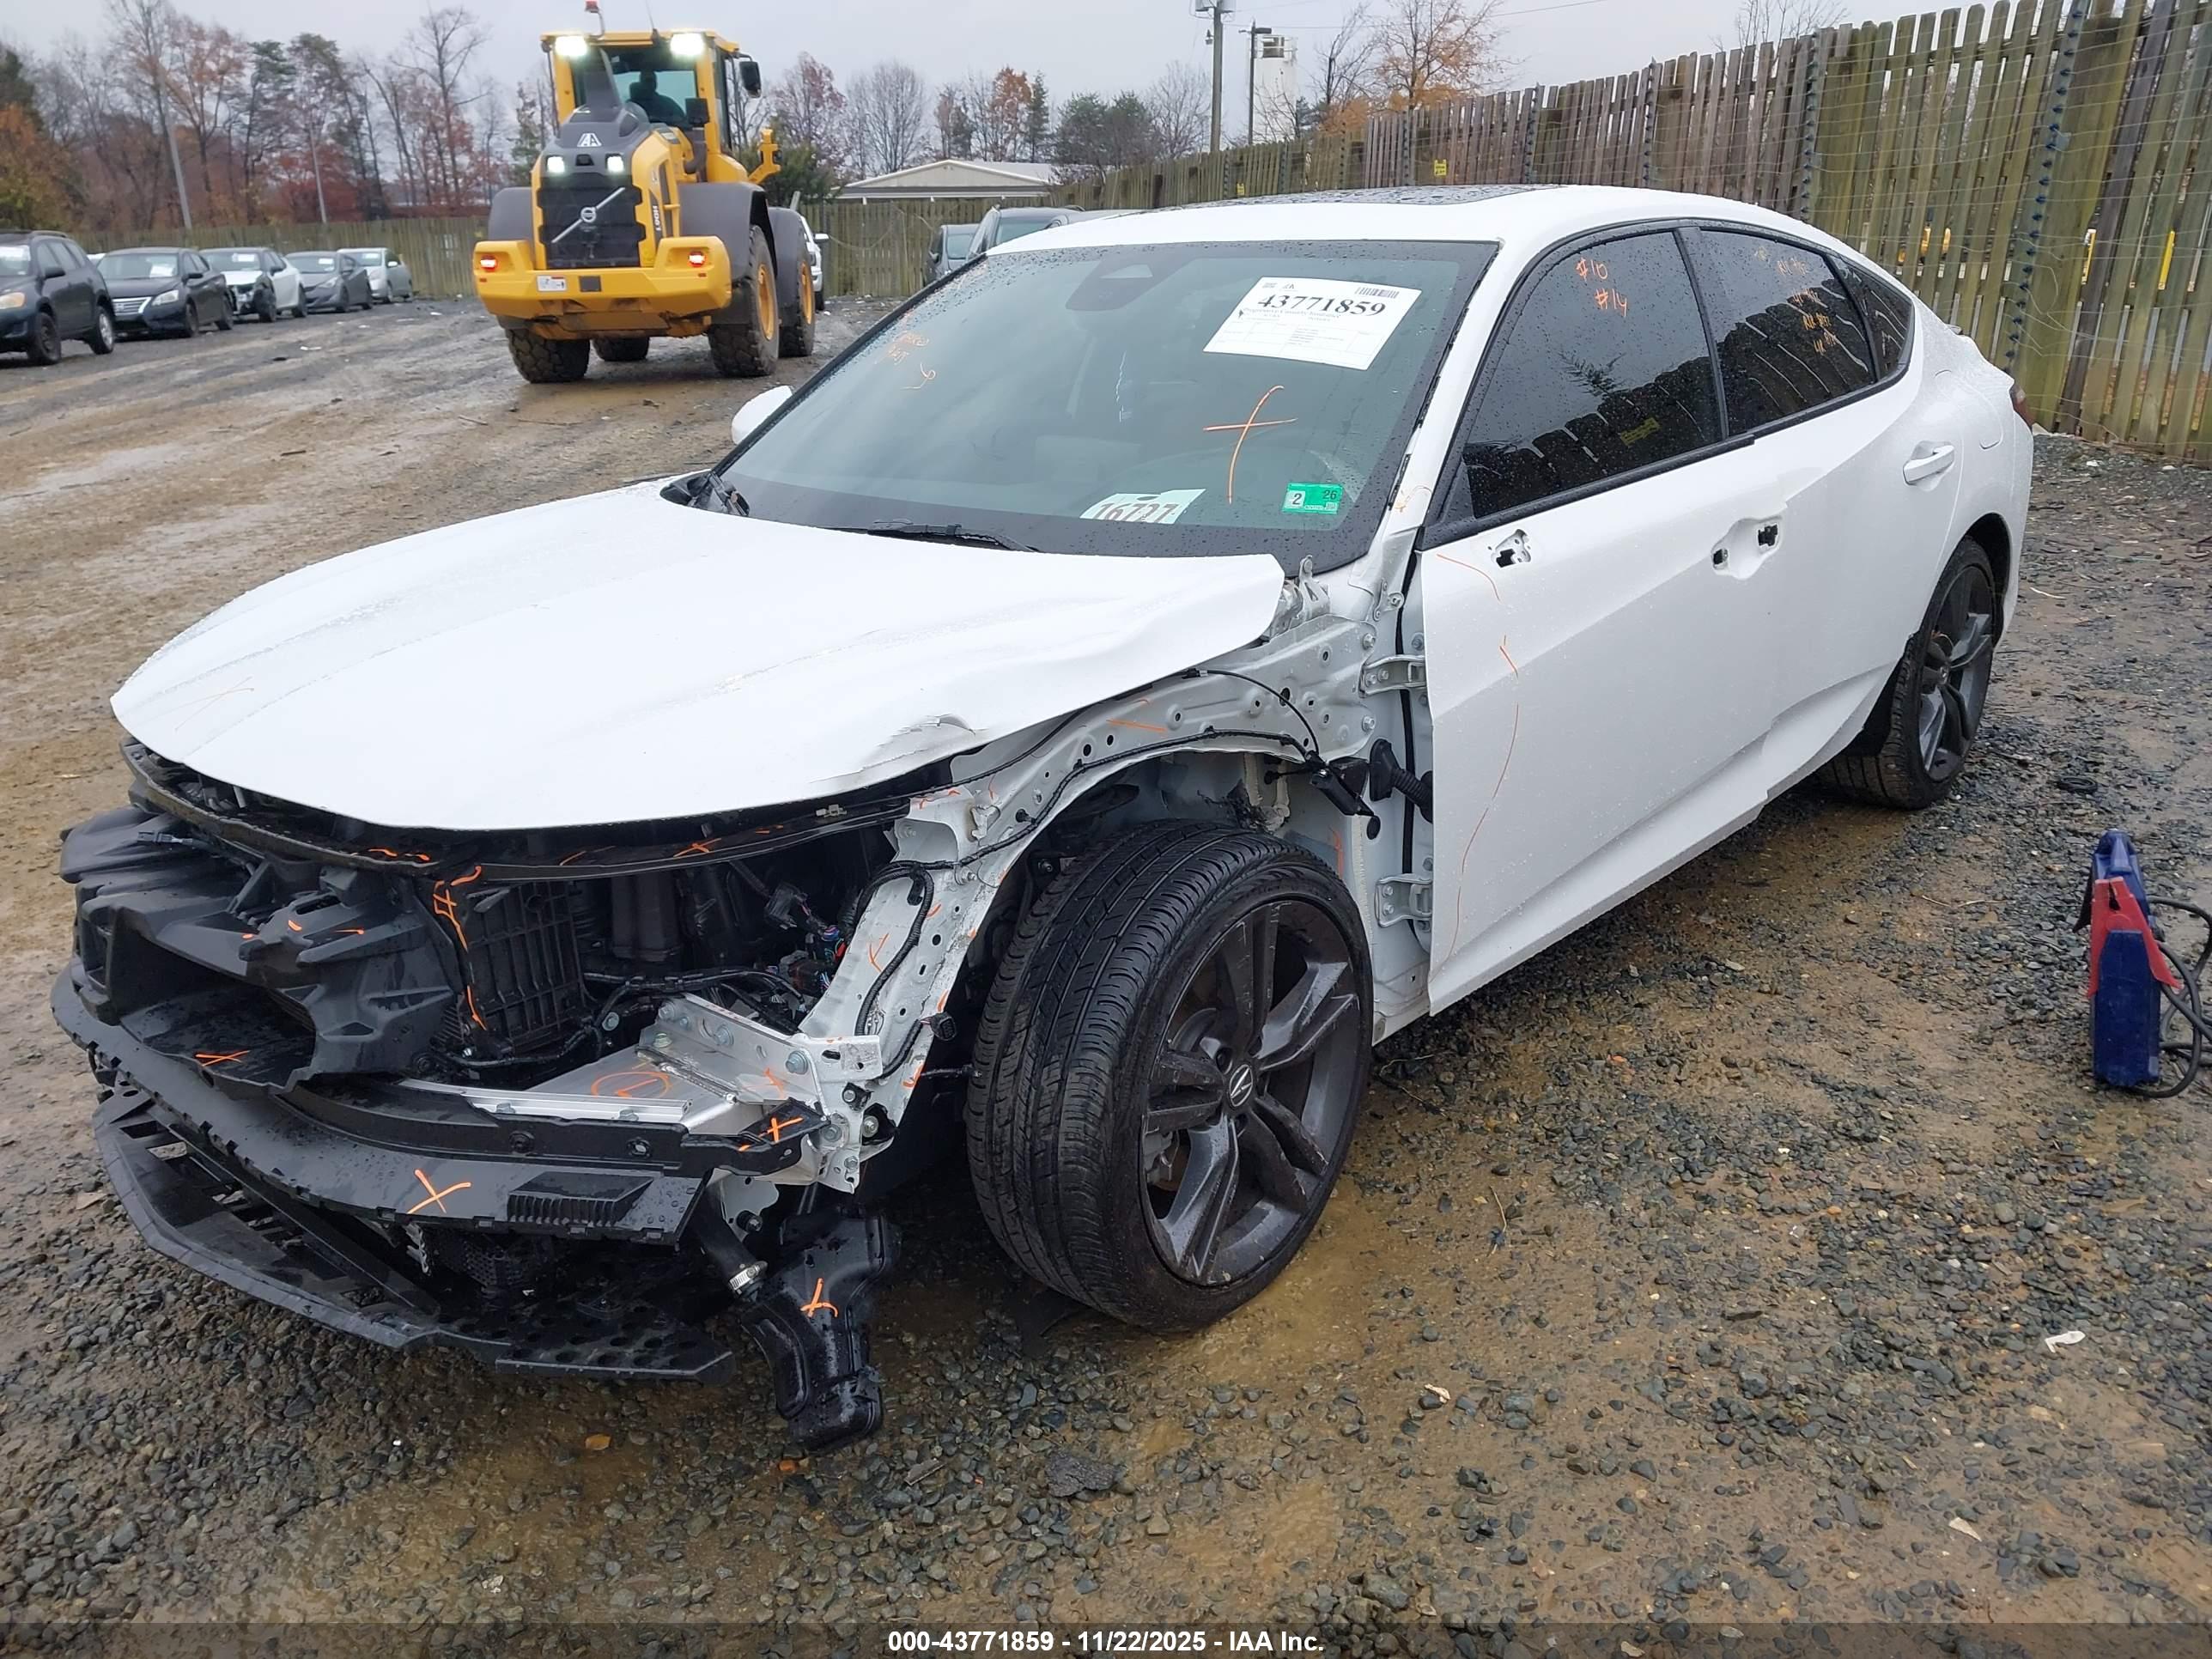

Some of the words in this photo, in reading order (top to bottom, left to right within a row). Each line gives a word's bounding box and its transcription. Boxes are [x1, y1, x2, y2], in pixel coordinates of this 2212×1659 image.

[1257, 295, 1386, 316] 43771859
[1595, 288, 1627, 317] #14
[1291, 493, 1302, 505] 2
[1322, 489, 1338, 500] 26
